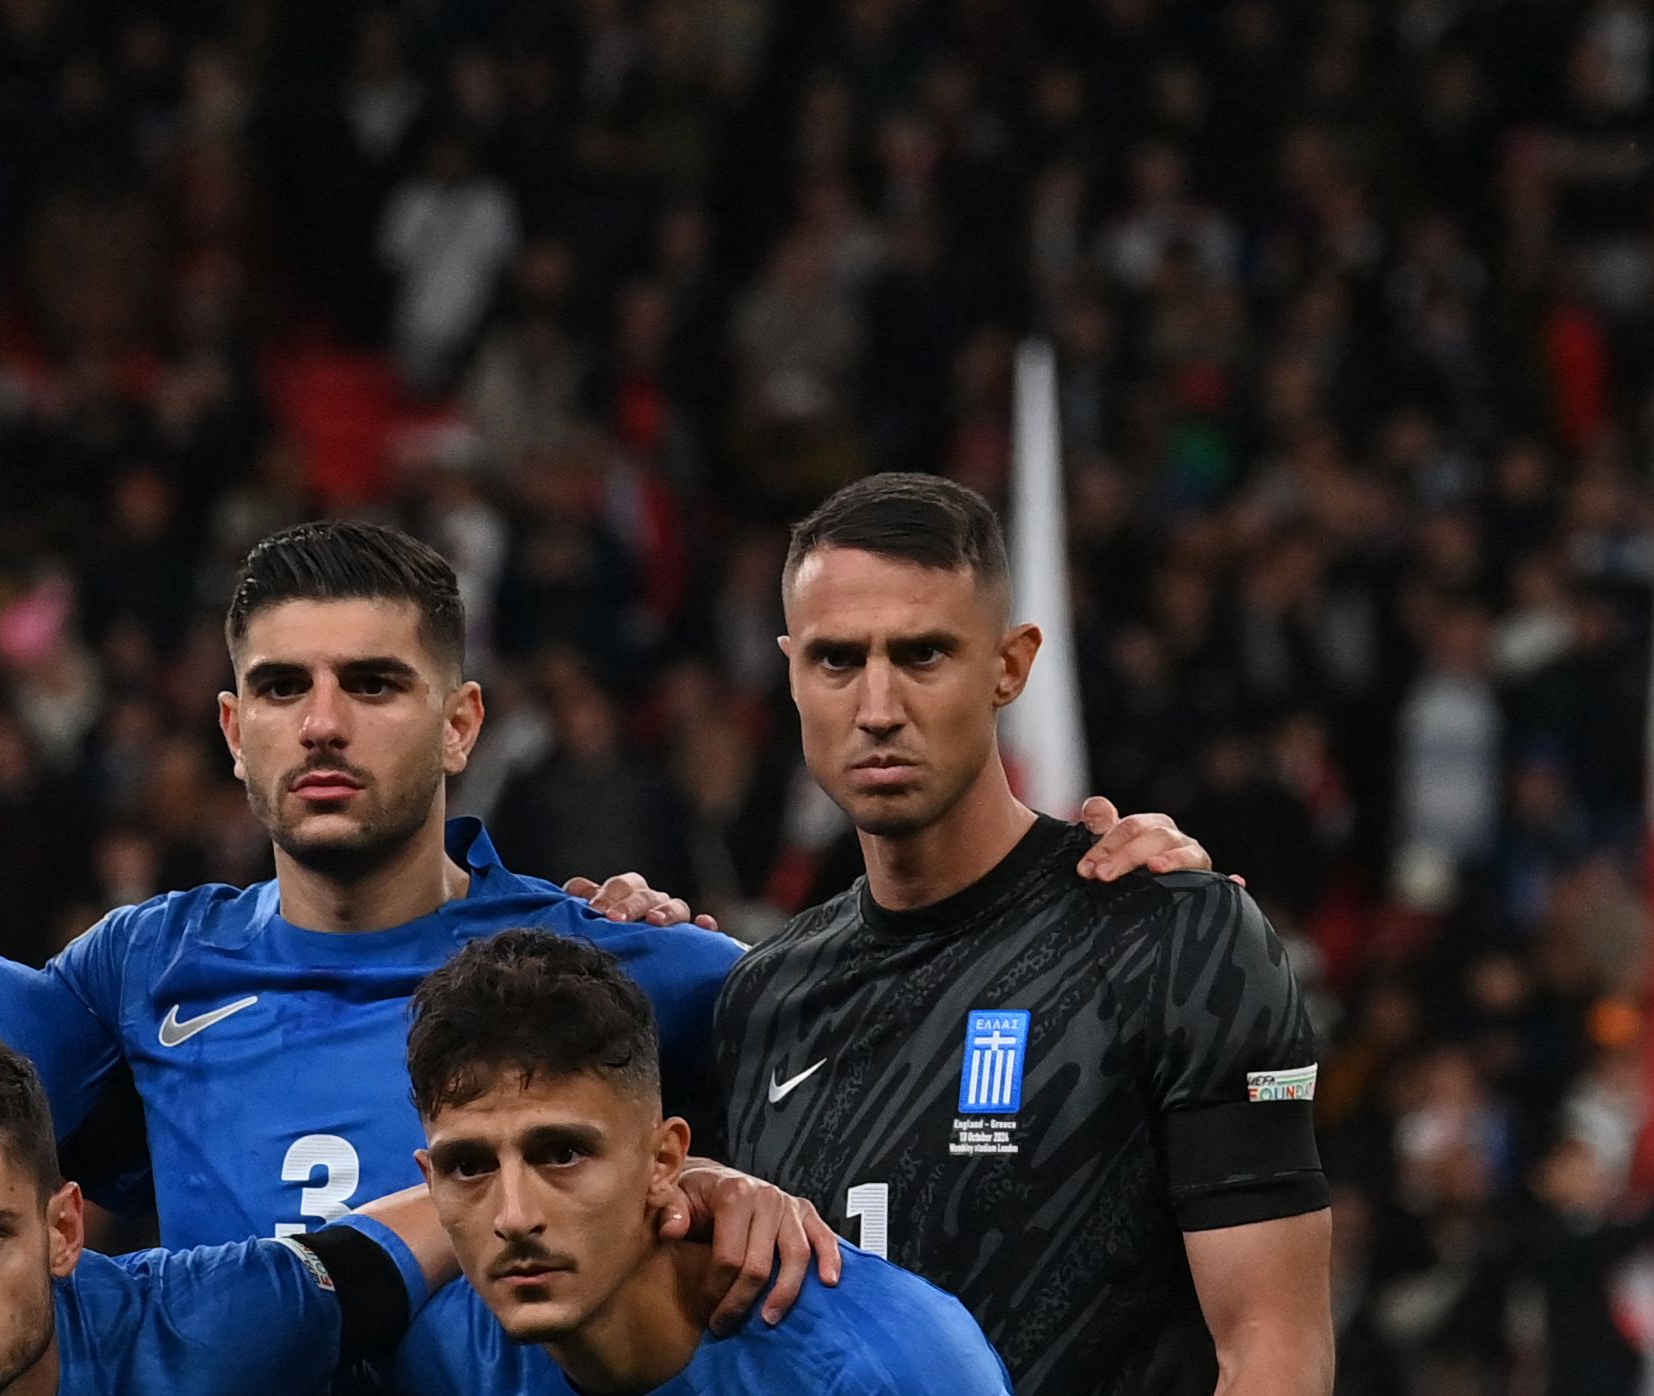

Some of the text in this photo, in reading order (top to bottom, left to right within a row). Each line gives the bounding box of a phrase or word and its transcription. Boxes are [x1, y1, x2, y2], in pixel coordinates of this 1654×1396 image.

[976, 1019, 1020, 1030] ΕΛΛΑΣ
[275, 1134, 360, 1238] 3
[846, 1182, 889, 1260] 1
